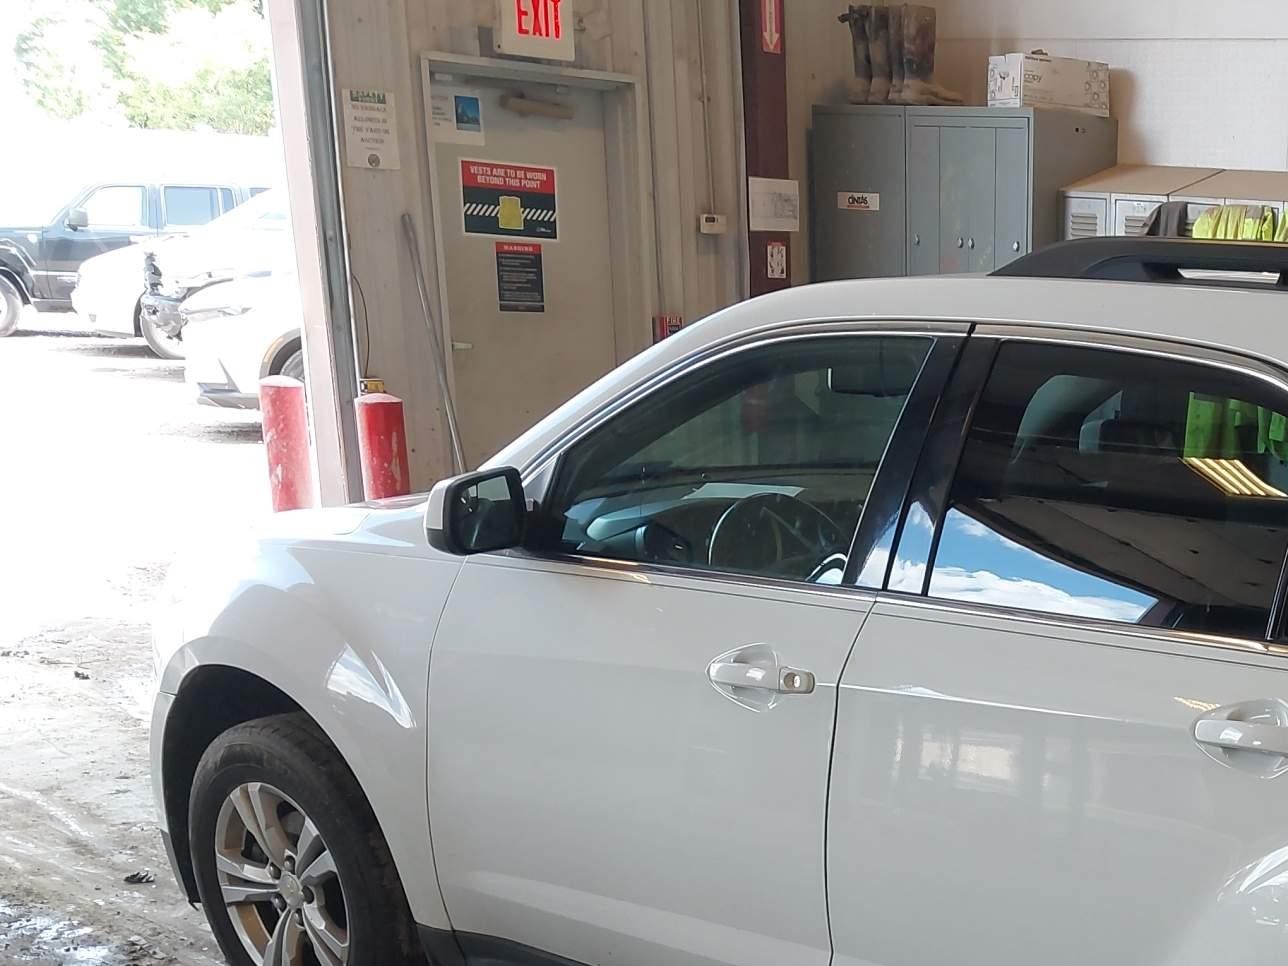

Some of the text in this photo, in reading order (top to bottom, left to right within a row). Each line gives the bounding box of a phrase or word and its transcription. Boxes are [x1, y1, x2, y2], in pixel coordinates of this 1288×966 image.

[516, 0, 560, 39] EXIT
[470, 165, 547, 180] VESTS ARE TO BE WORN
[477, 175, 540, 188] BEYOND THIS POINT
